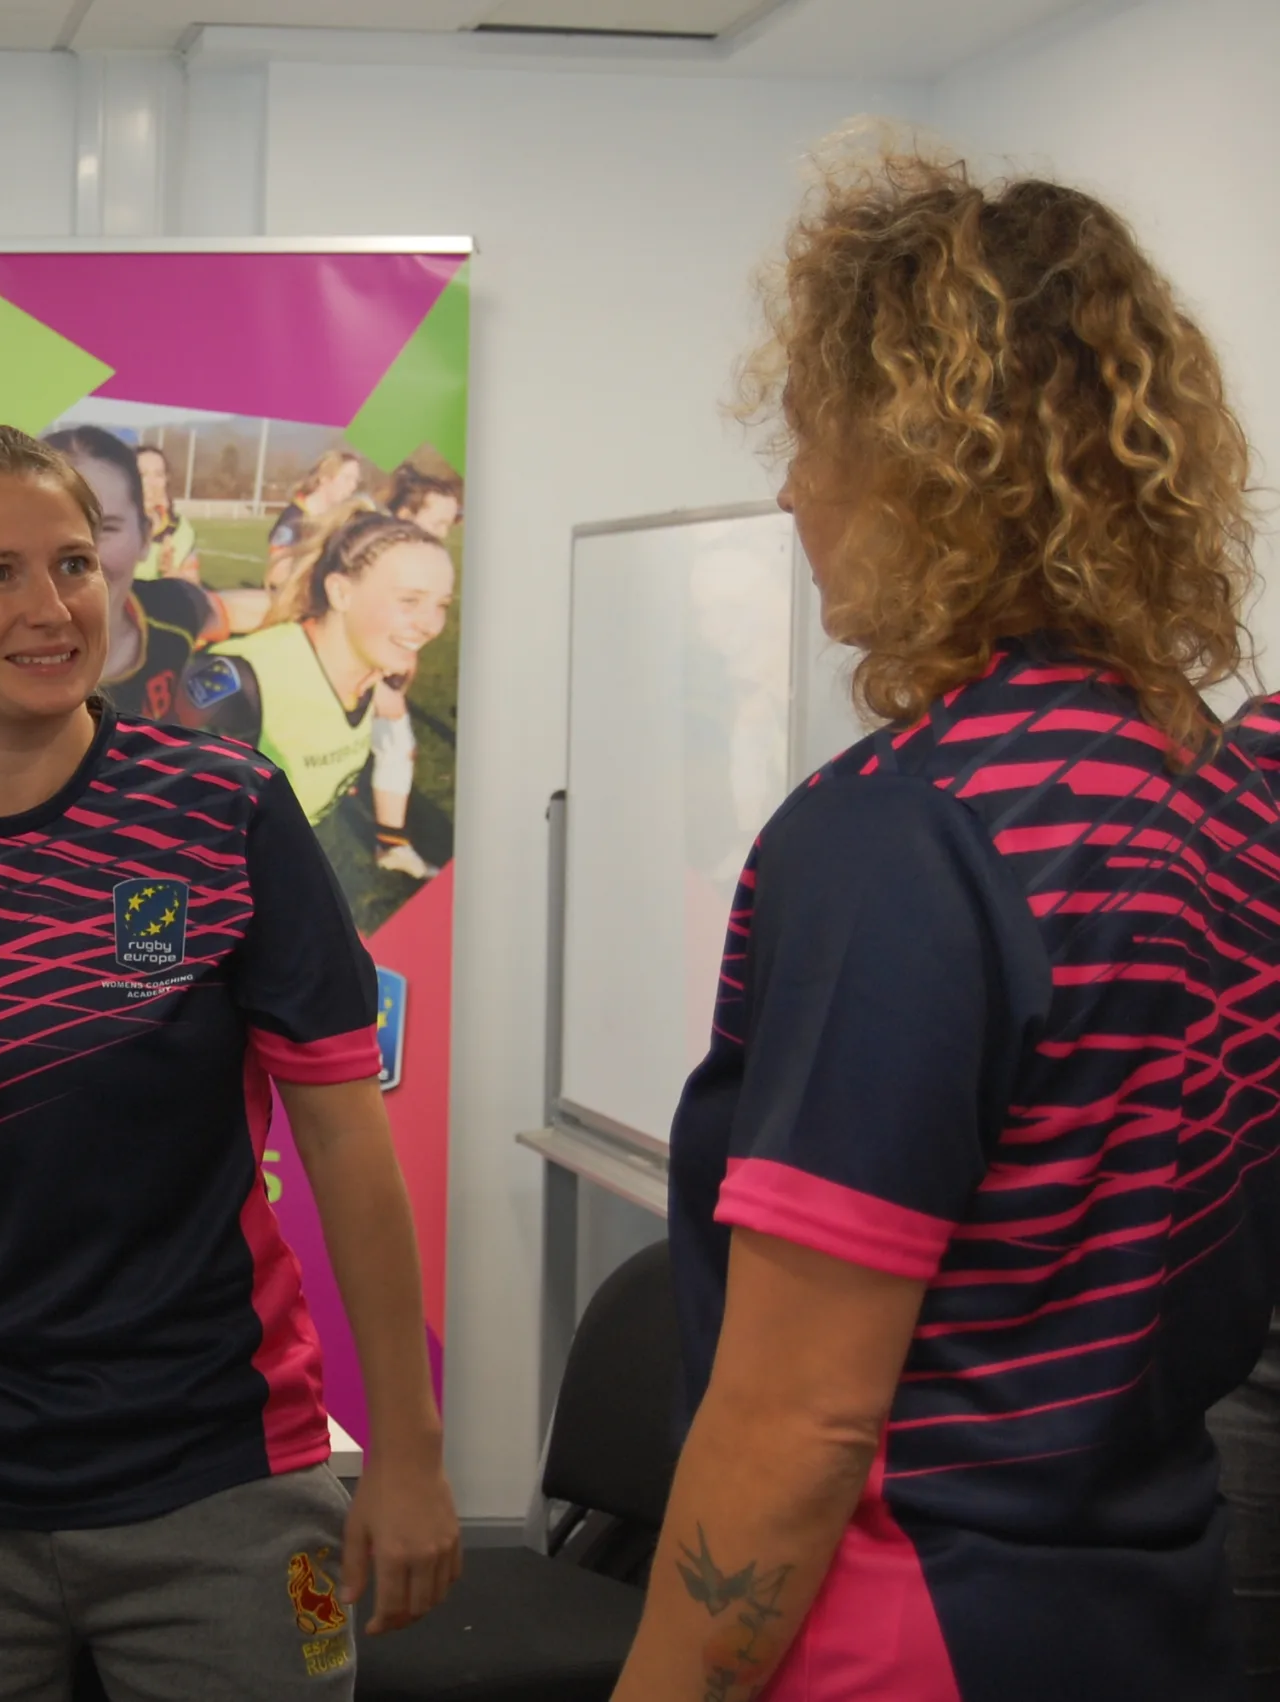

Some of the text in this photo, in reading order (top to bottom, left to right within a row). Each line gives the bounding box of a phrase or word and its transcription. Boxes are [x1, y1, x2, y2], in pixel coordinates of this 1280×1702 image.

[128, 940, 172, 953] rugby
[123, 953, 177, 965] europe
[101, 974, 194, 989] WOMENS COACHING
[127, 985, 172, 999] ACADEMY
